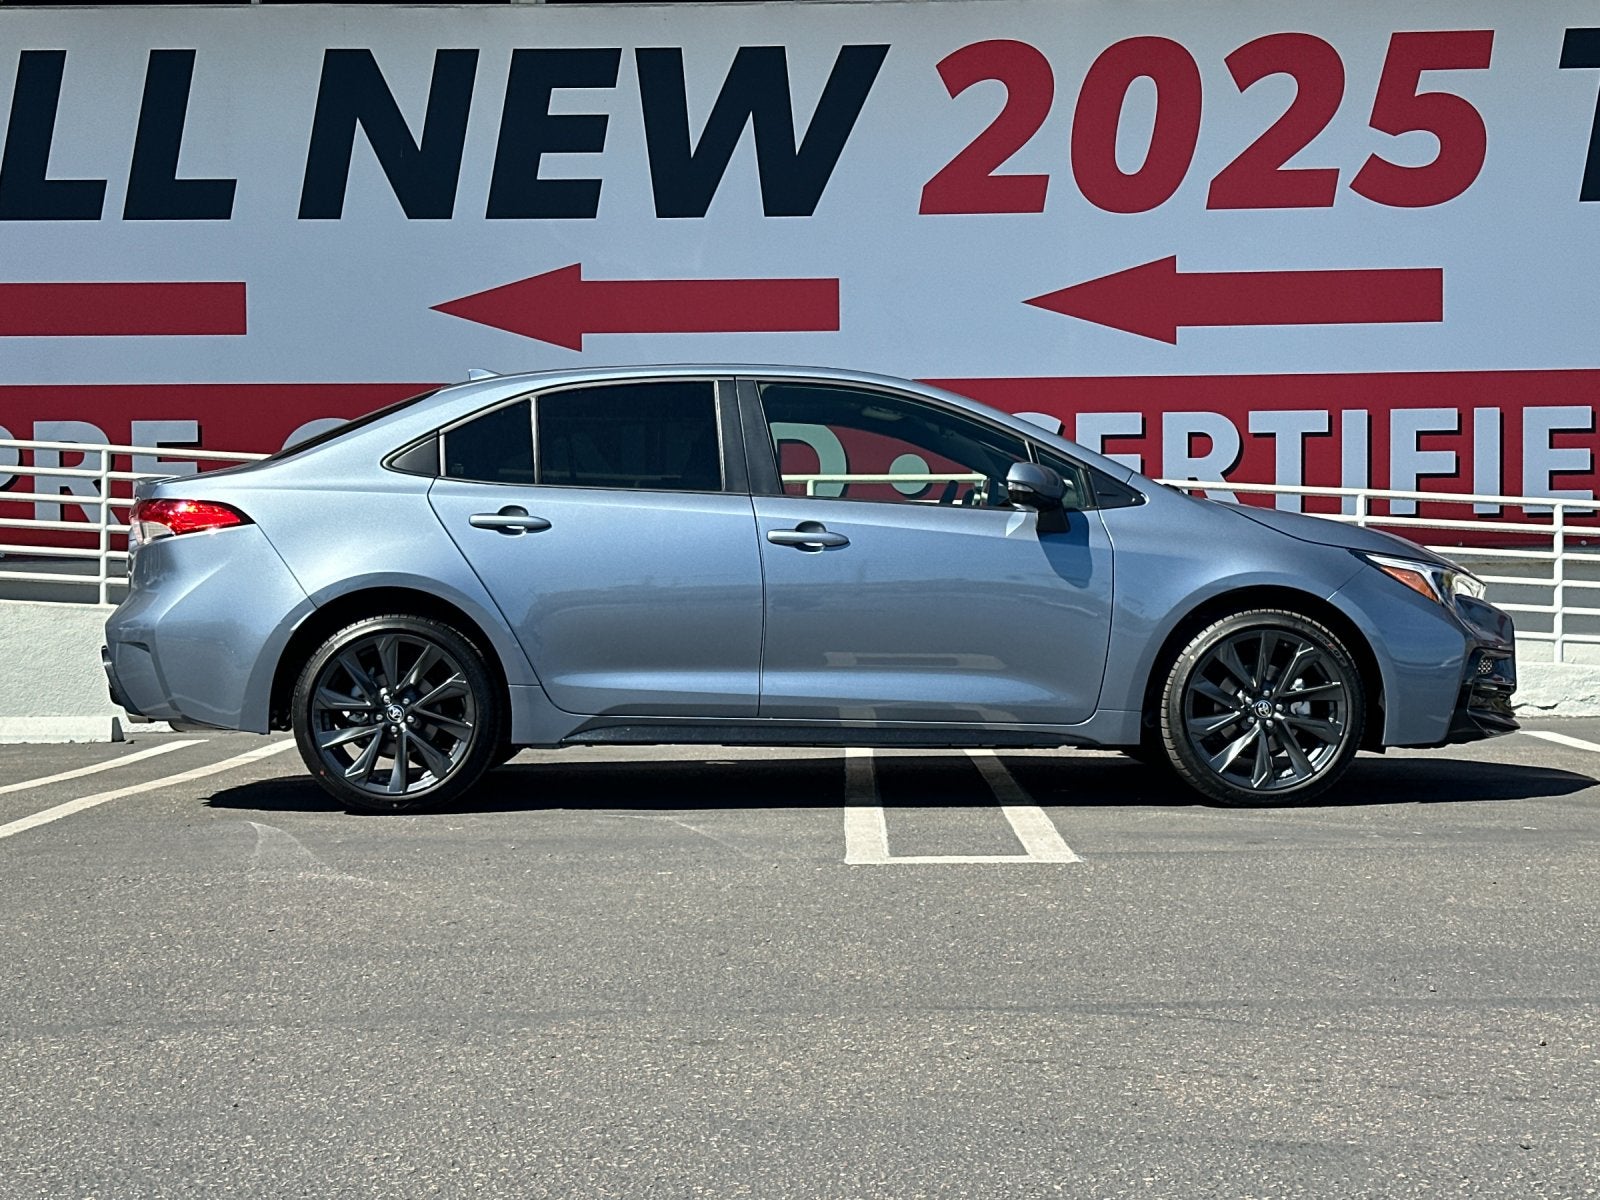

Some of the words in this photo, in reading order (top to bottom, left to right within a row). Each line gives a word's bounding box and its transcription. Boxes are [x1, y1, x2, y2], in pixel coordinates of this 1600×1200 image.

[298, 44, 891, 219] NEW
[918, 29, 1495, 215] 2025
[0, 420, 201, 525] RE
[1010, 405, 1595, 515] ERTIFIE
